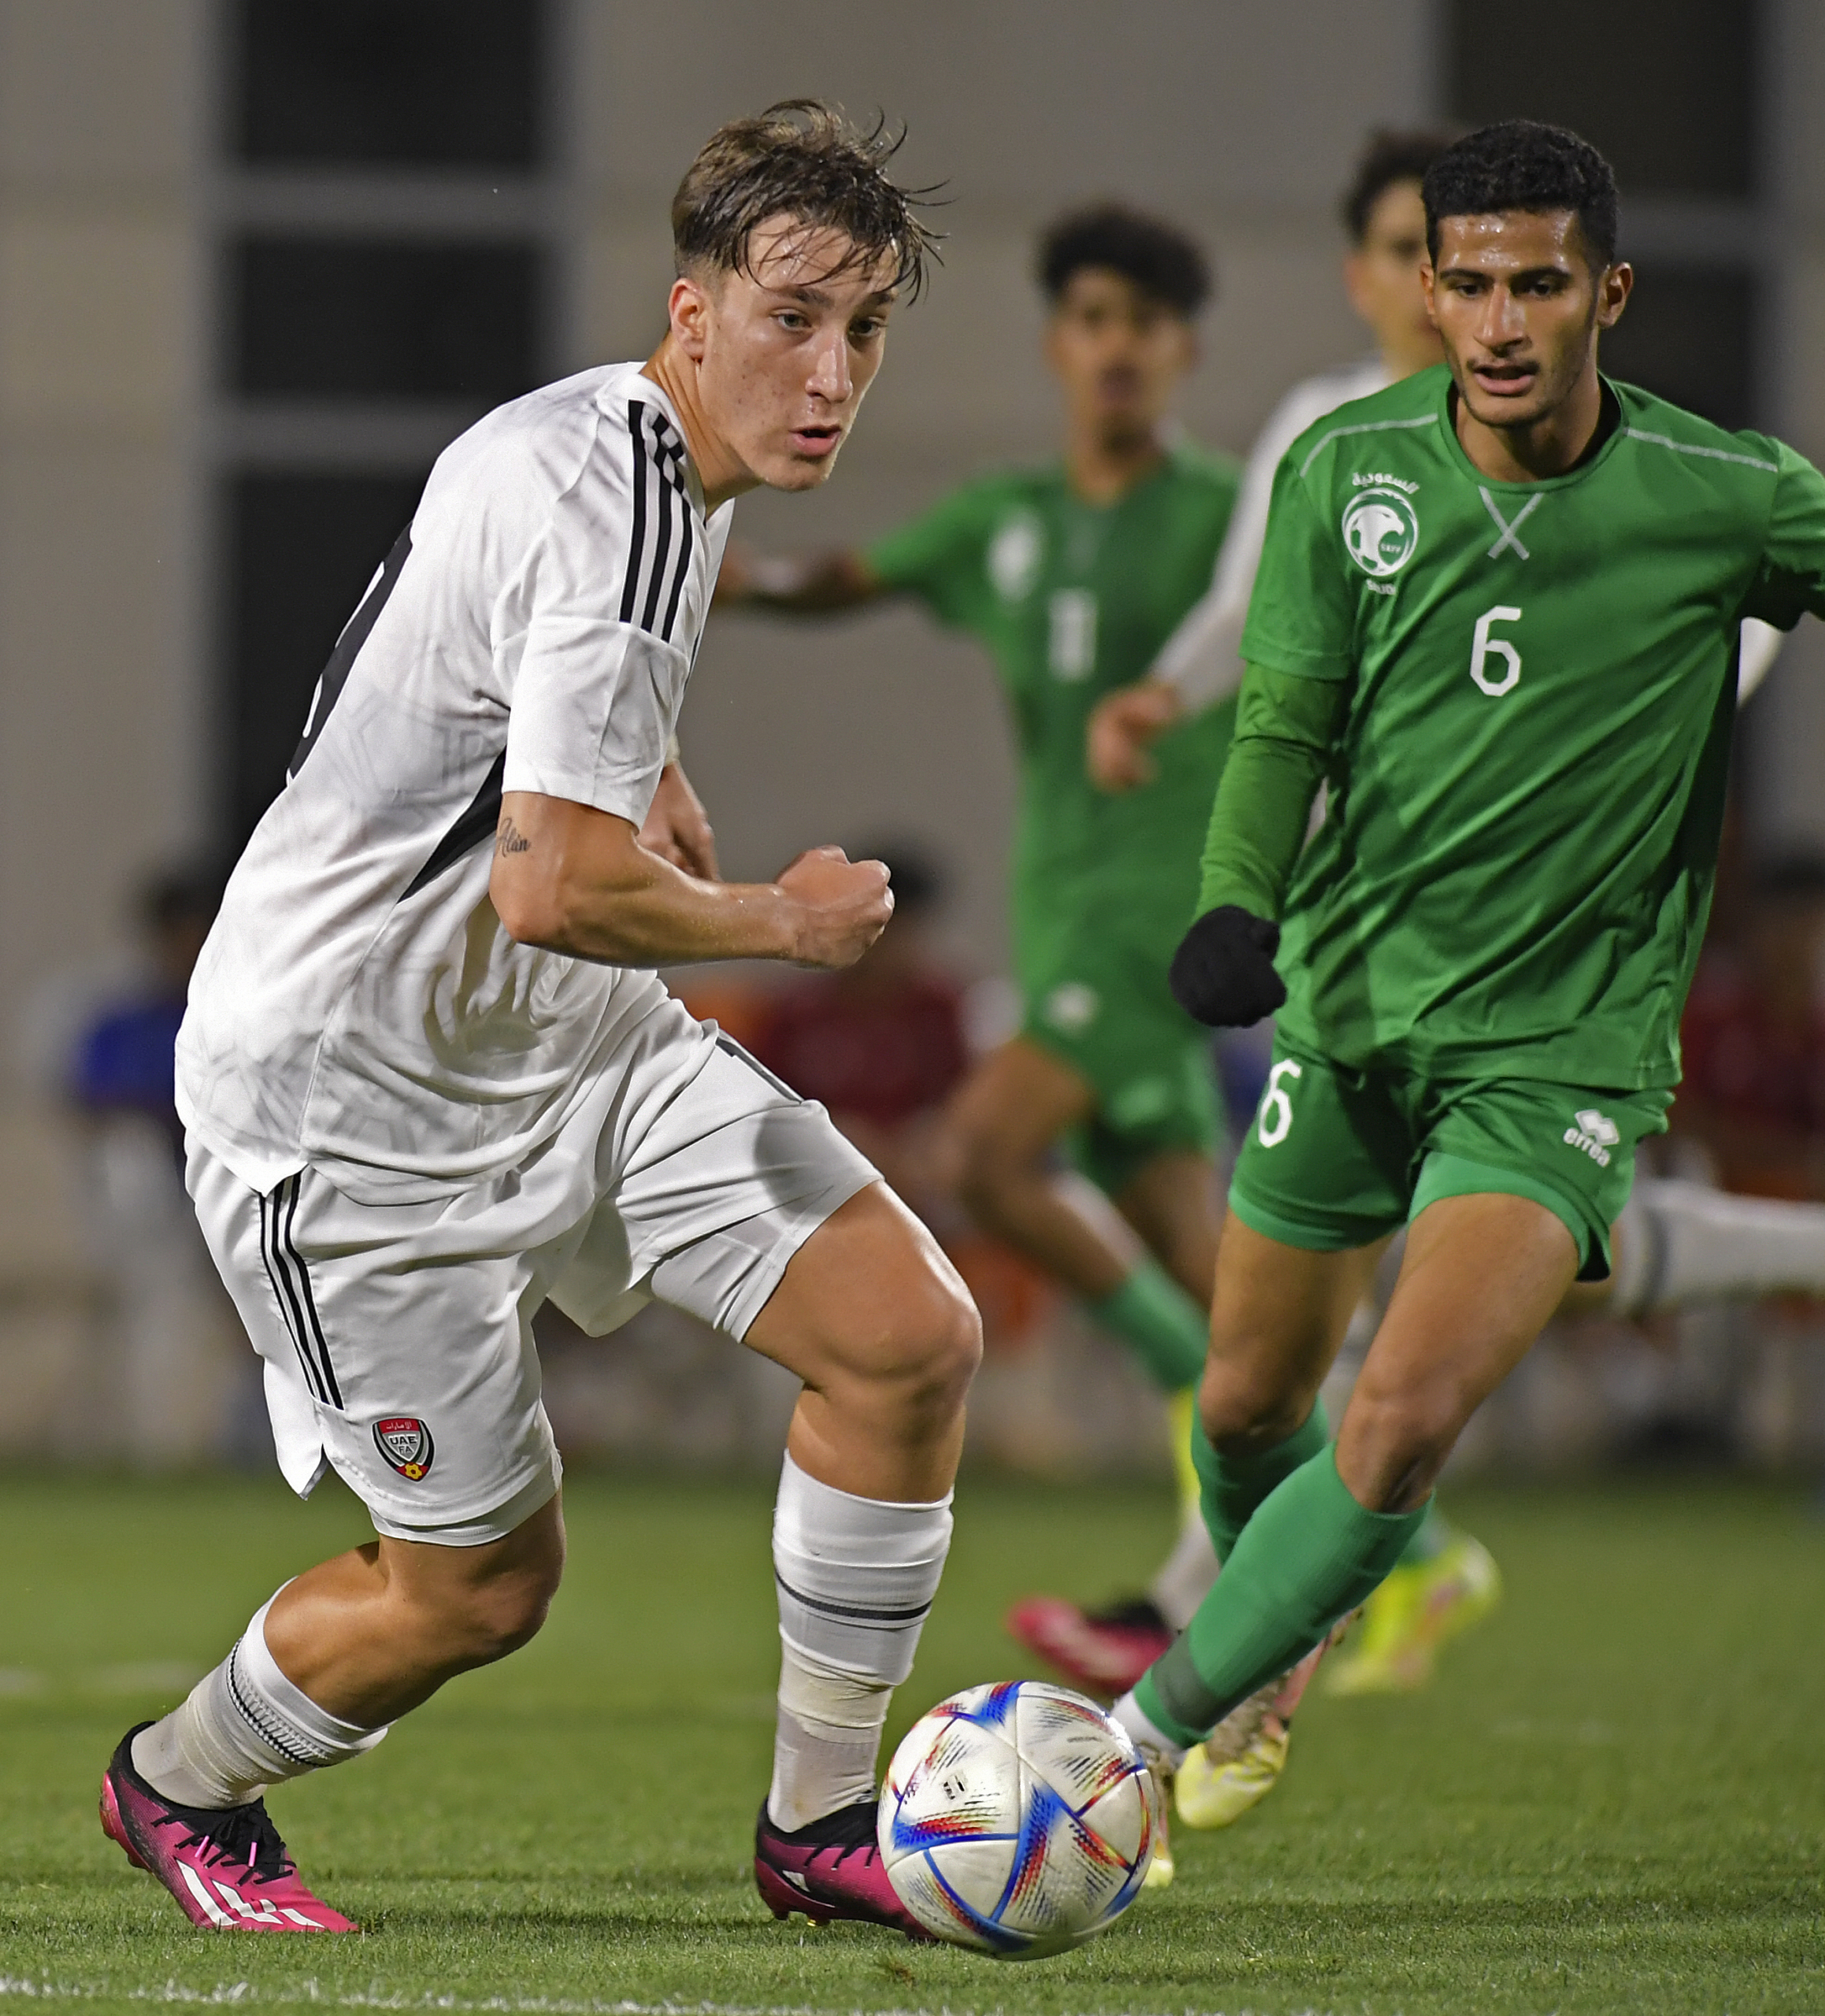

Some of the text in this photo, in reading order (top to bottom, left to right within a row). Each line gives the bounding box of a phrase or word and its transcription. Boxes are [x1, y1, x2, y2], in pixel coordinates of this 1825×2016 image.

[1470, 605, 1522, 696] 6
[1257, 1058, 1302, 1148] 6
[389, 1436, 417, 1445] UAE
